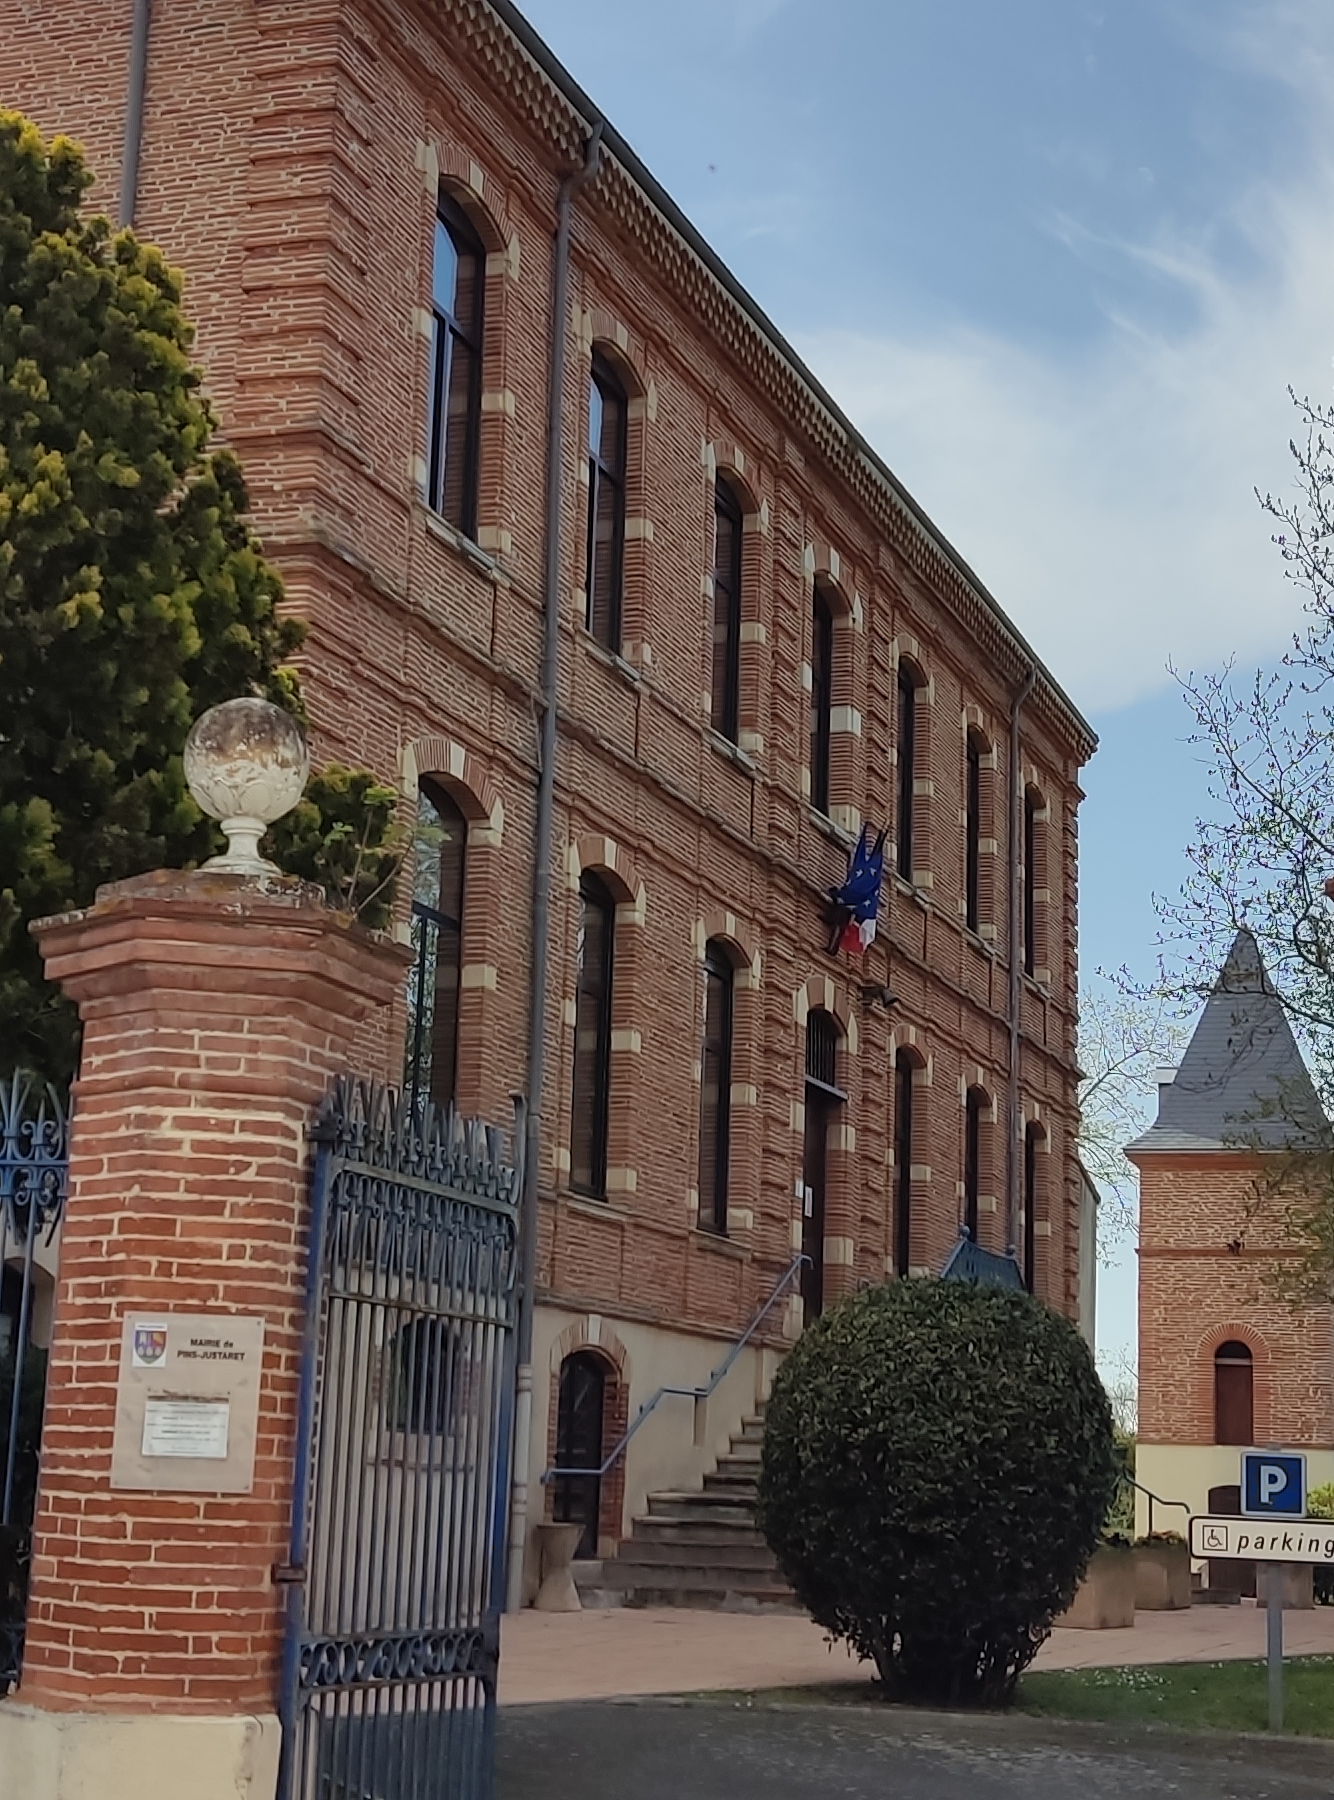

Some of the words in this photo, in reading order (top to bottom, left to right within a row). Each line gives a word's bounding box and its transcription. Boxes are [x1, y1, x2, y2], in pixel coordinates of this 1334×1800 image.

[190, 1338, 221, 1348] MAIRIE
[223, 1339, 234, 1348] de
[177, 1350, 245, 1361] PINS-JUSTARET
[1260, 1464, 1288, 1504] P
